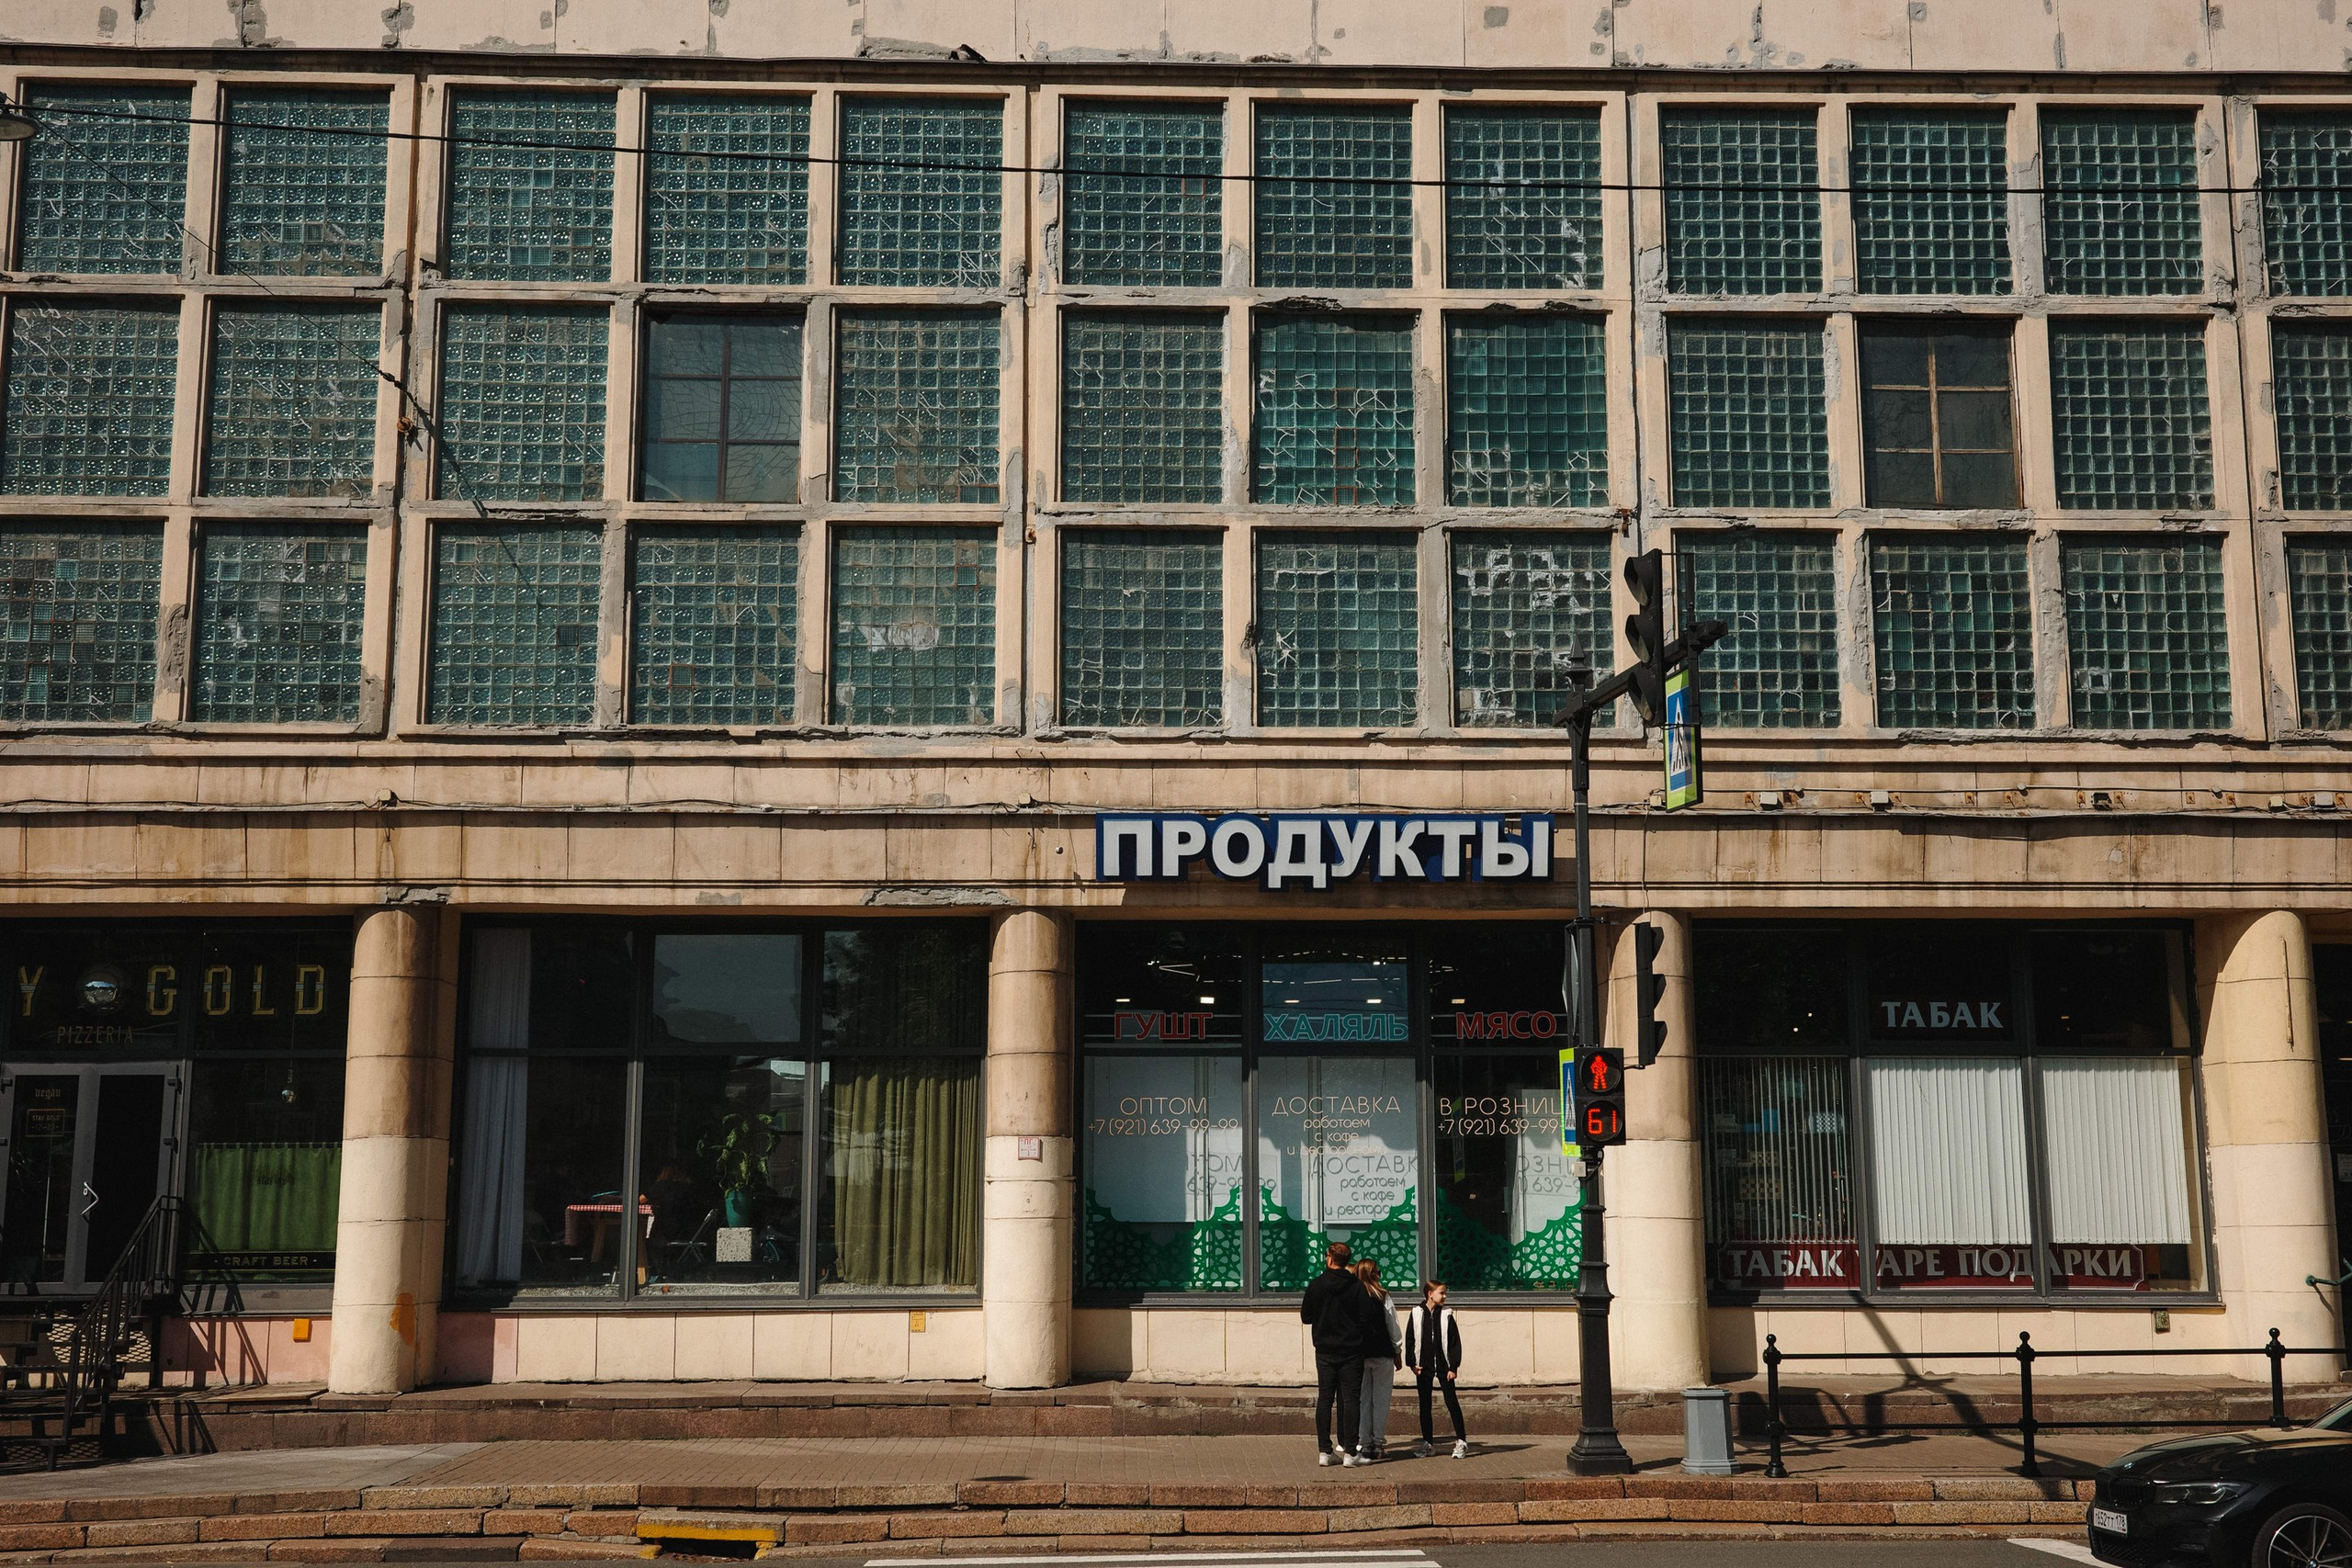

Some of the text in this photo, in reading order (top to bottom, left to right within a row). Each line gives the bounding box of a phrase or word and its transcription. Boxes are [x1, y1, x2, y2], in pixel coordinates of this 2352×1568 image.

[1101, 817, 1551, 890] ПРОДУКТЫ
[146, 964, 326, 1016] GOLD
[1881, 1000, 2004, 1029] ТАБАК
[56, 1025, 134, 1045] PIZZERIA
[1114, 1011, 1214, 1040] ГУШТ
[1263, 1012, 1409, 1042] ХАЛЯЛЬ
[1455, 1010, 1557, 1040] МЯСО
[34, 1088, 62, 1100] vegan
[1119, 1097, 1207, 1116] ОПТОМ
[1272, 1096, 1402, 1117] ДОСТАВКА
[1440, 1097, 1453, 1116] В
[1149, 1118, 1239, 1135] 639-99-99
[1303, 1115, 1371, 1132] работаем
[1587, 1108, 1617, 1135] 61
[1314, 1132, 1360, 1145] с кафе
[1286, 1145, 1296, 1156] и
[222, 1255, 310, 1267] CRAFT BEER
[1727, 1249, 1847, 1278] ТАБАК
